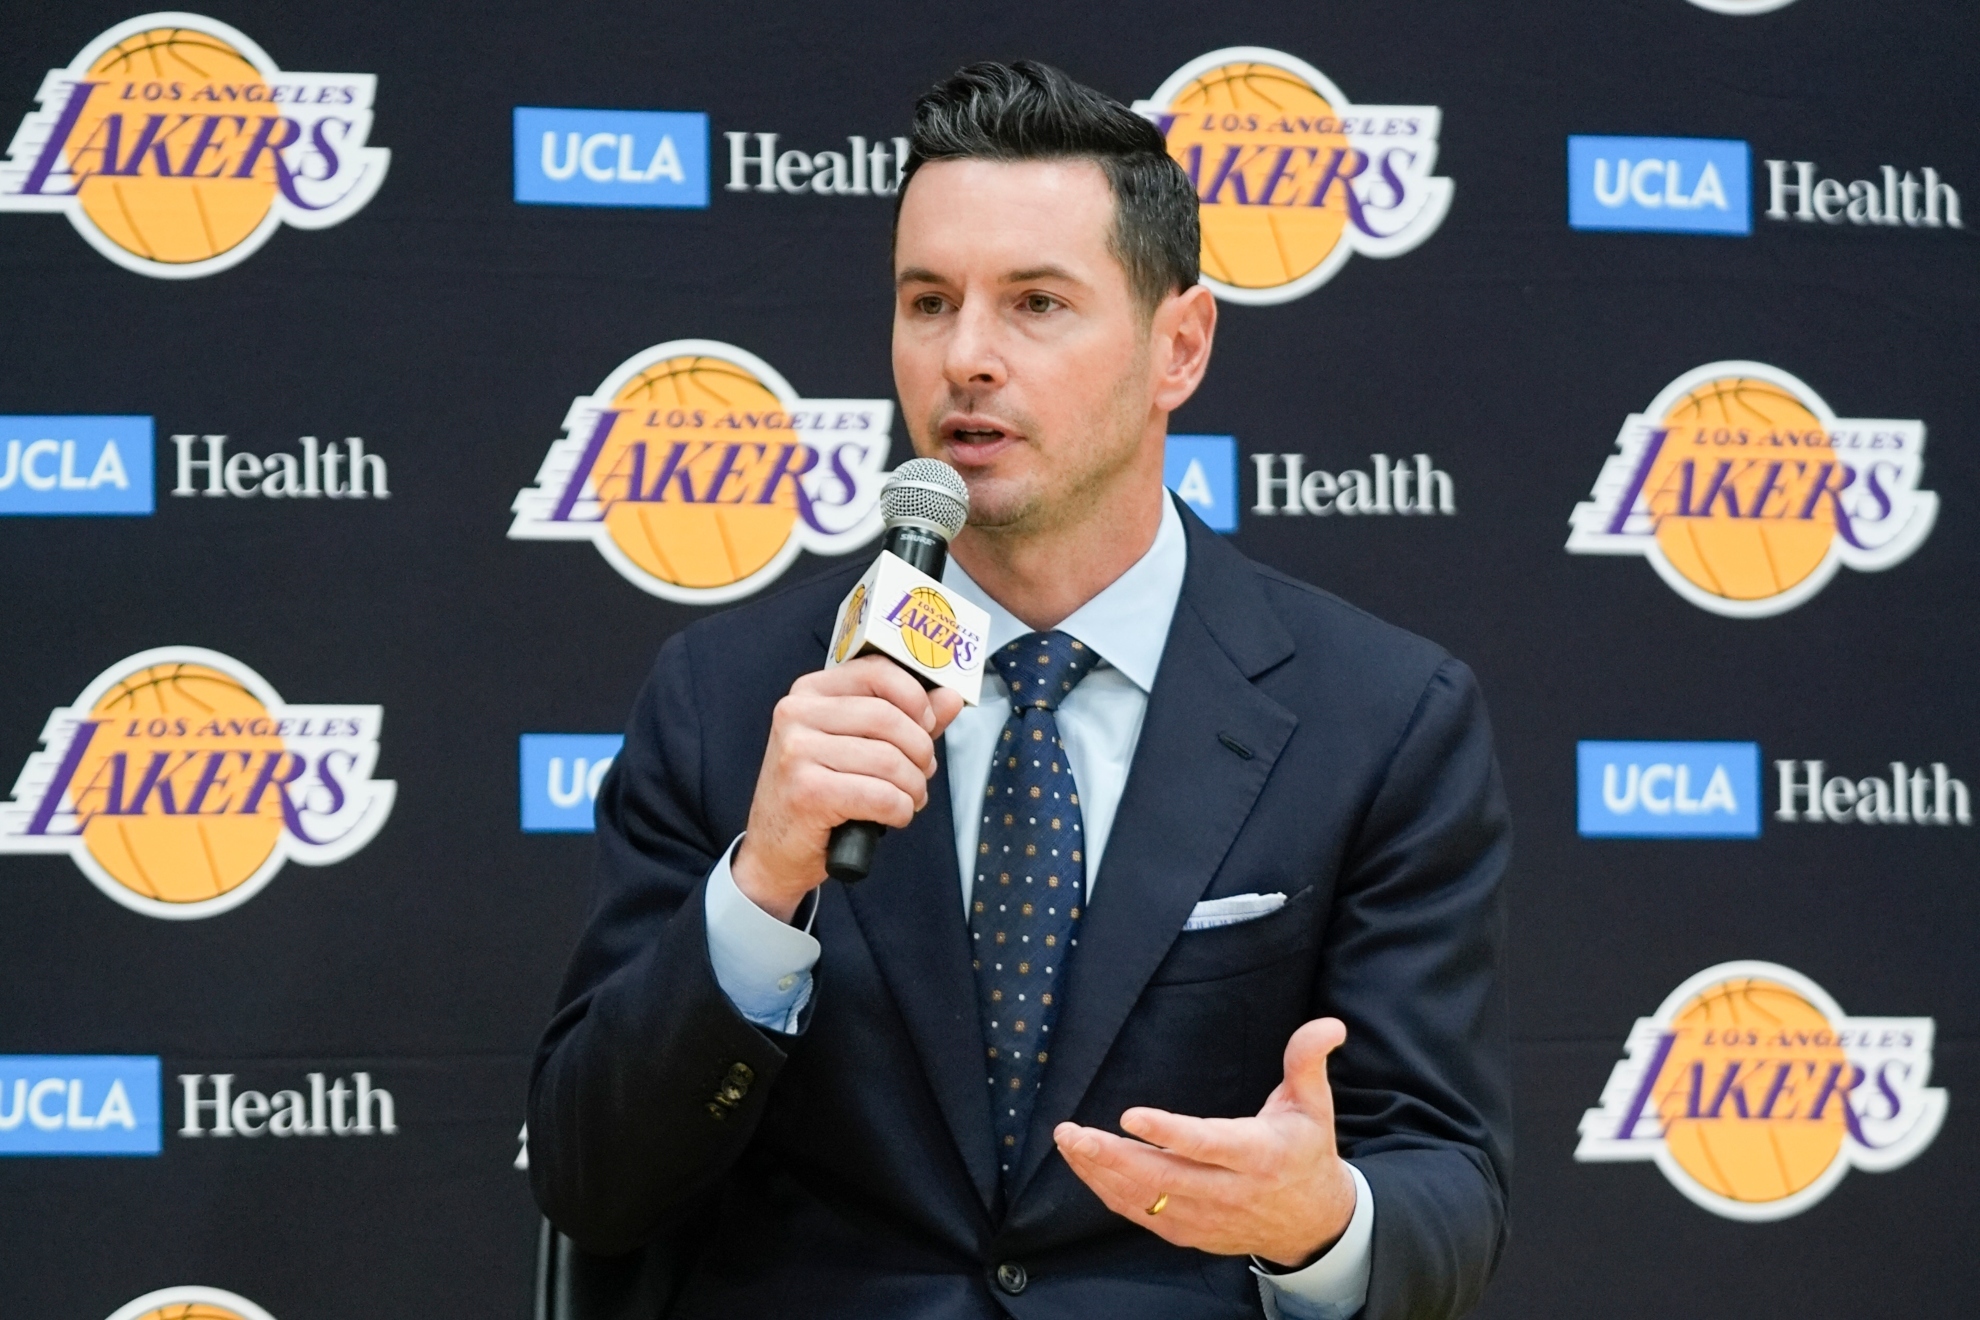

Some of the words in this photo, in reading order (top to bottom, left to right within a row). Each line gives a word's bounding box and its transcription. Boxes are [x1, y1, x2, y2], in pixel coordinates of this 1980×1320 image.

[121, 82, 183, 101] LOS
[191, 82, 358, 104] ANGELES
[1200, 113, 1258, 132] LOS
[1266, 116, 1420, 135] ANGELES
[18, 81, 369, 211] LAKERS
[540, 131, 685, 184] UCLA
[1146, 112, 1431, 238] AKERS
[1593, 157, 1729, 210] UCLA
[1764, 159, 1964, 229] Health
[645, 409, 704, 428] LOS
[713, 411, 873, 431] ANGELES
[1693, 427, 1748, 446] LOS
[1758, 429, 1906, 449] ANGELES
[170, 434, 391, 499] Health
[547, 408, 880, 535] LAKERS
[1250, 453, 1457, 516] Health
[1602, 426, 1918, 550] LAKERS
[884, 592, 979, 671] LAKERS
[917, 601, 935, 614] LOS
[936, 612, 980, 642] ANGELES
[124, 717, 188, 738] LOS
[196, 717, 363, 738] ANGELES
[22, 719, 374, 845] LAKERS
[1602, 763, 1737, 815] UCLA
[1774, 759, 1972, 826] Health
[1703, 1028, 1757, 1046] LOS
[1767, 1028, 1916, 1048] ANGELES
[0, 1078, 136, 1130] UCLA
[177, 1071, 399, 1138] Health
[1611, 1028, 1927, 1149] LAKERS
